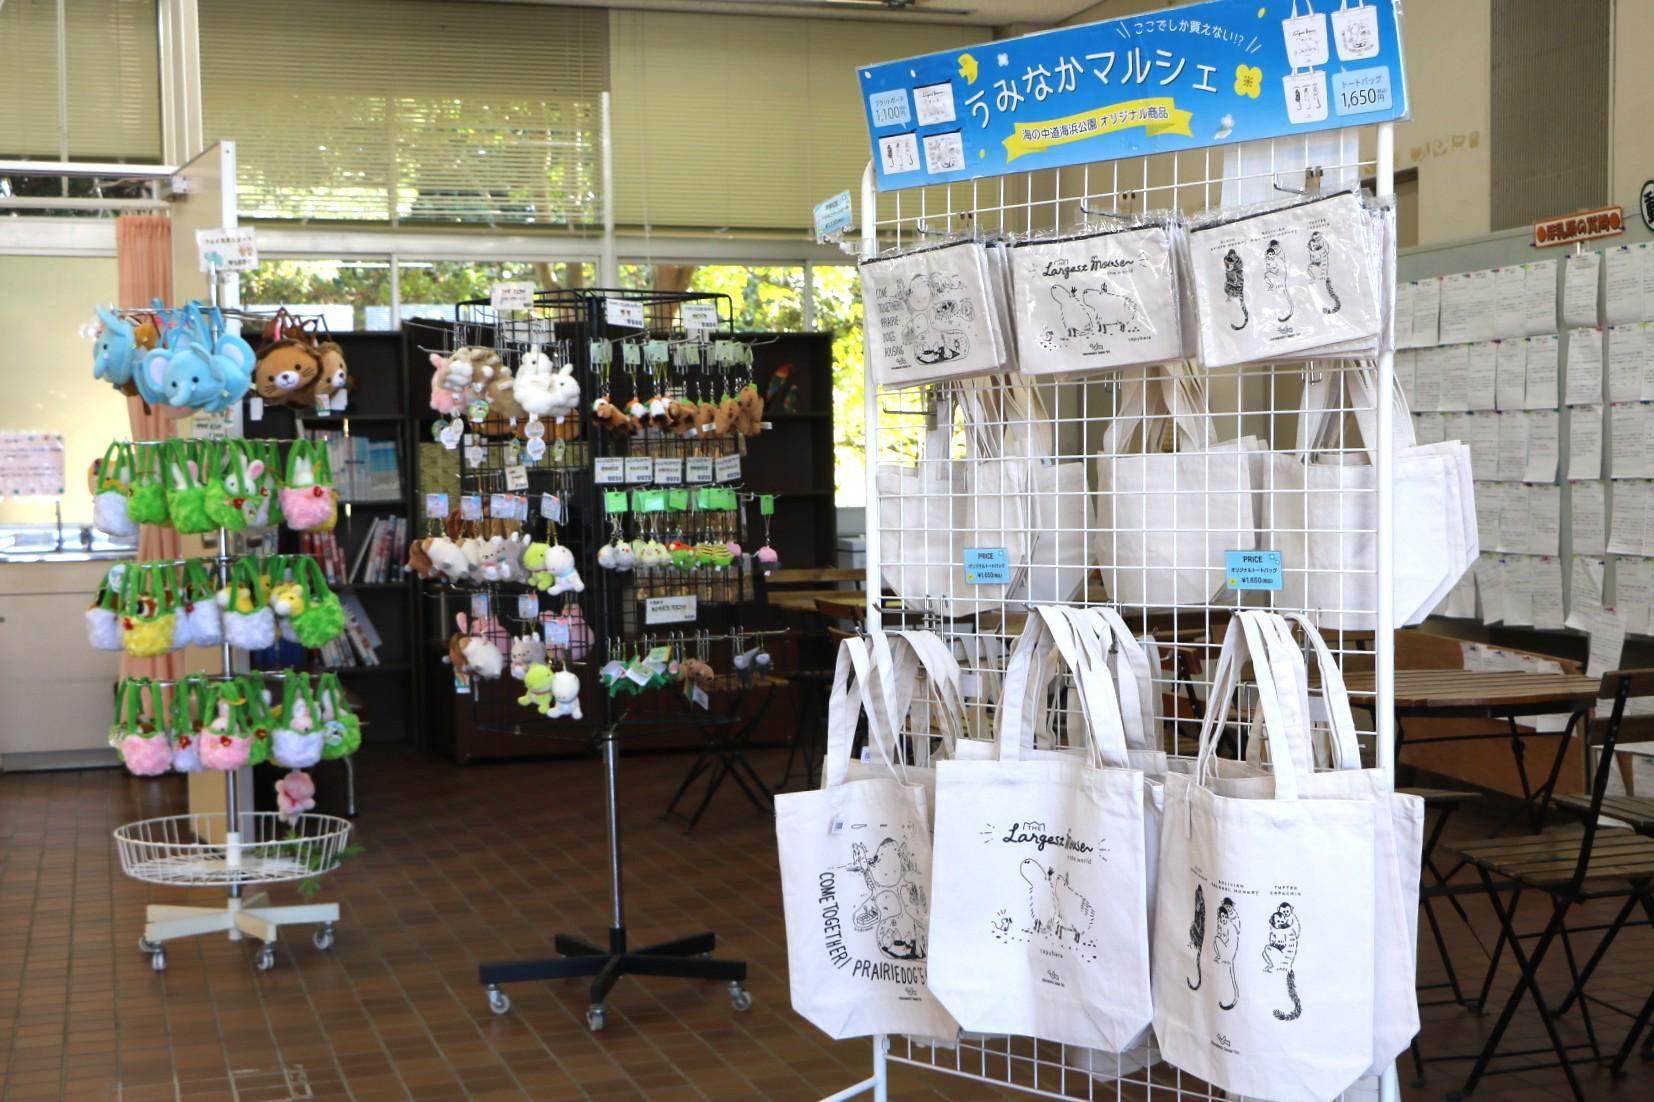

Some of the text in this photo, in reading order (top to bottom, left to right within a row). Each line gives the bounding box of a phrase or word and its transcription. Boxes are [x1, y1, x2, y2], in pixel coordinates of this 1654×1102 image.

[965, 47, 1218, 128] うみなかマルシェ
[1342, 75, 1382, 88] トートバッグ
[1022, 107, 1170, 141] 海の中道海浜公園 オリジナル商品
[1043, 262, 1088, 279] Largest
[1002, 823, 1064, 851] Largest
[819, 872, 836, 904] COME
